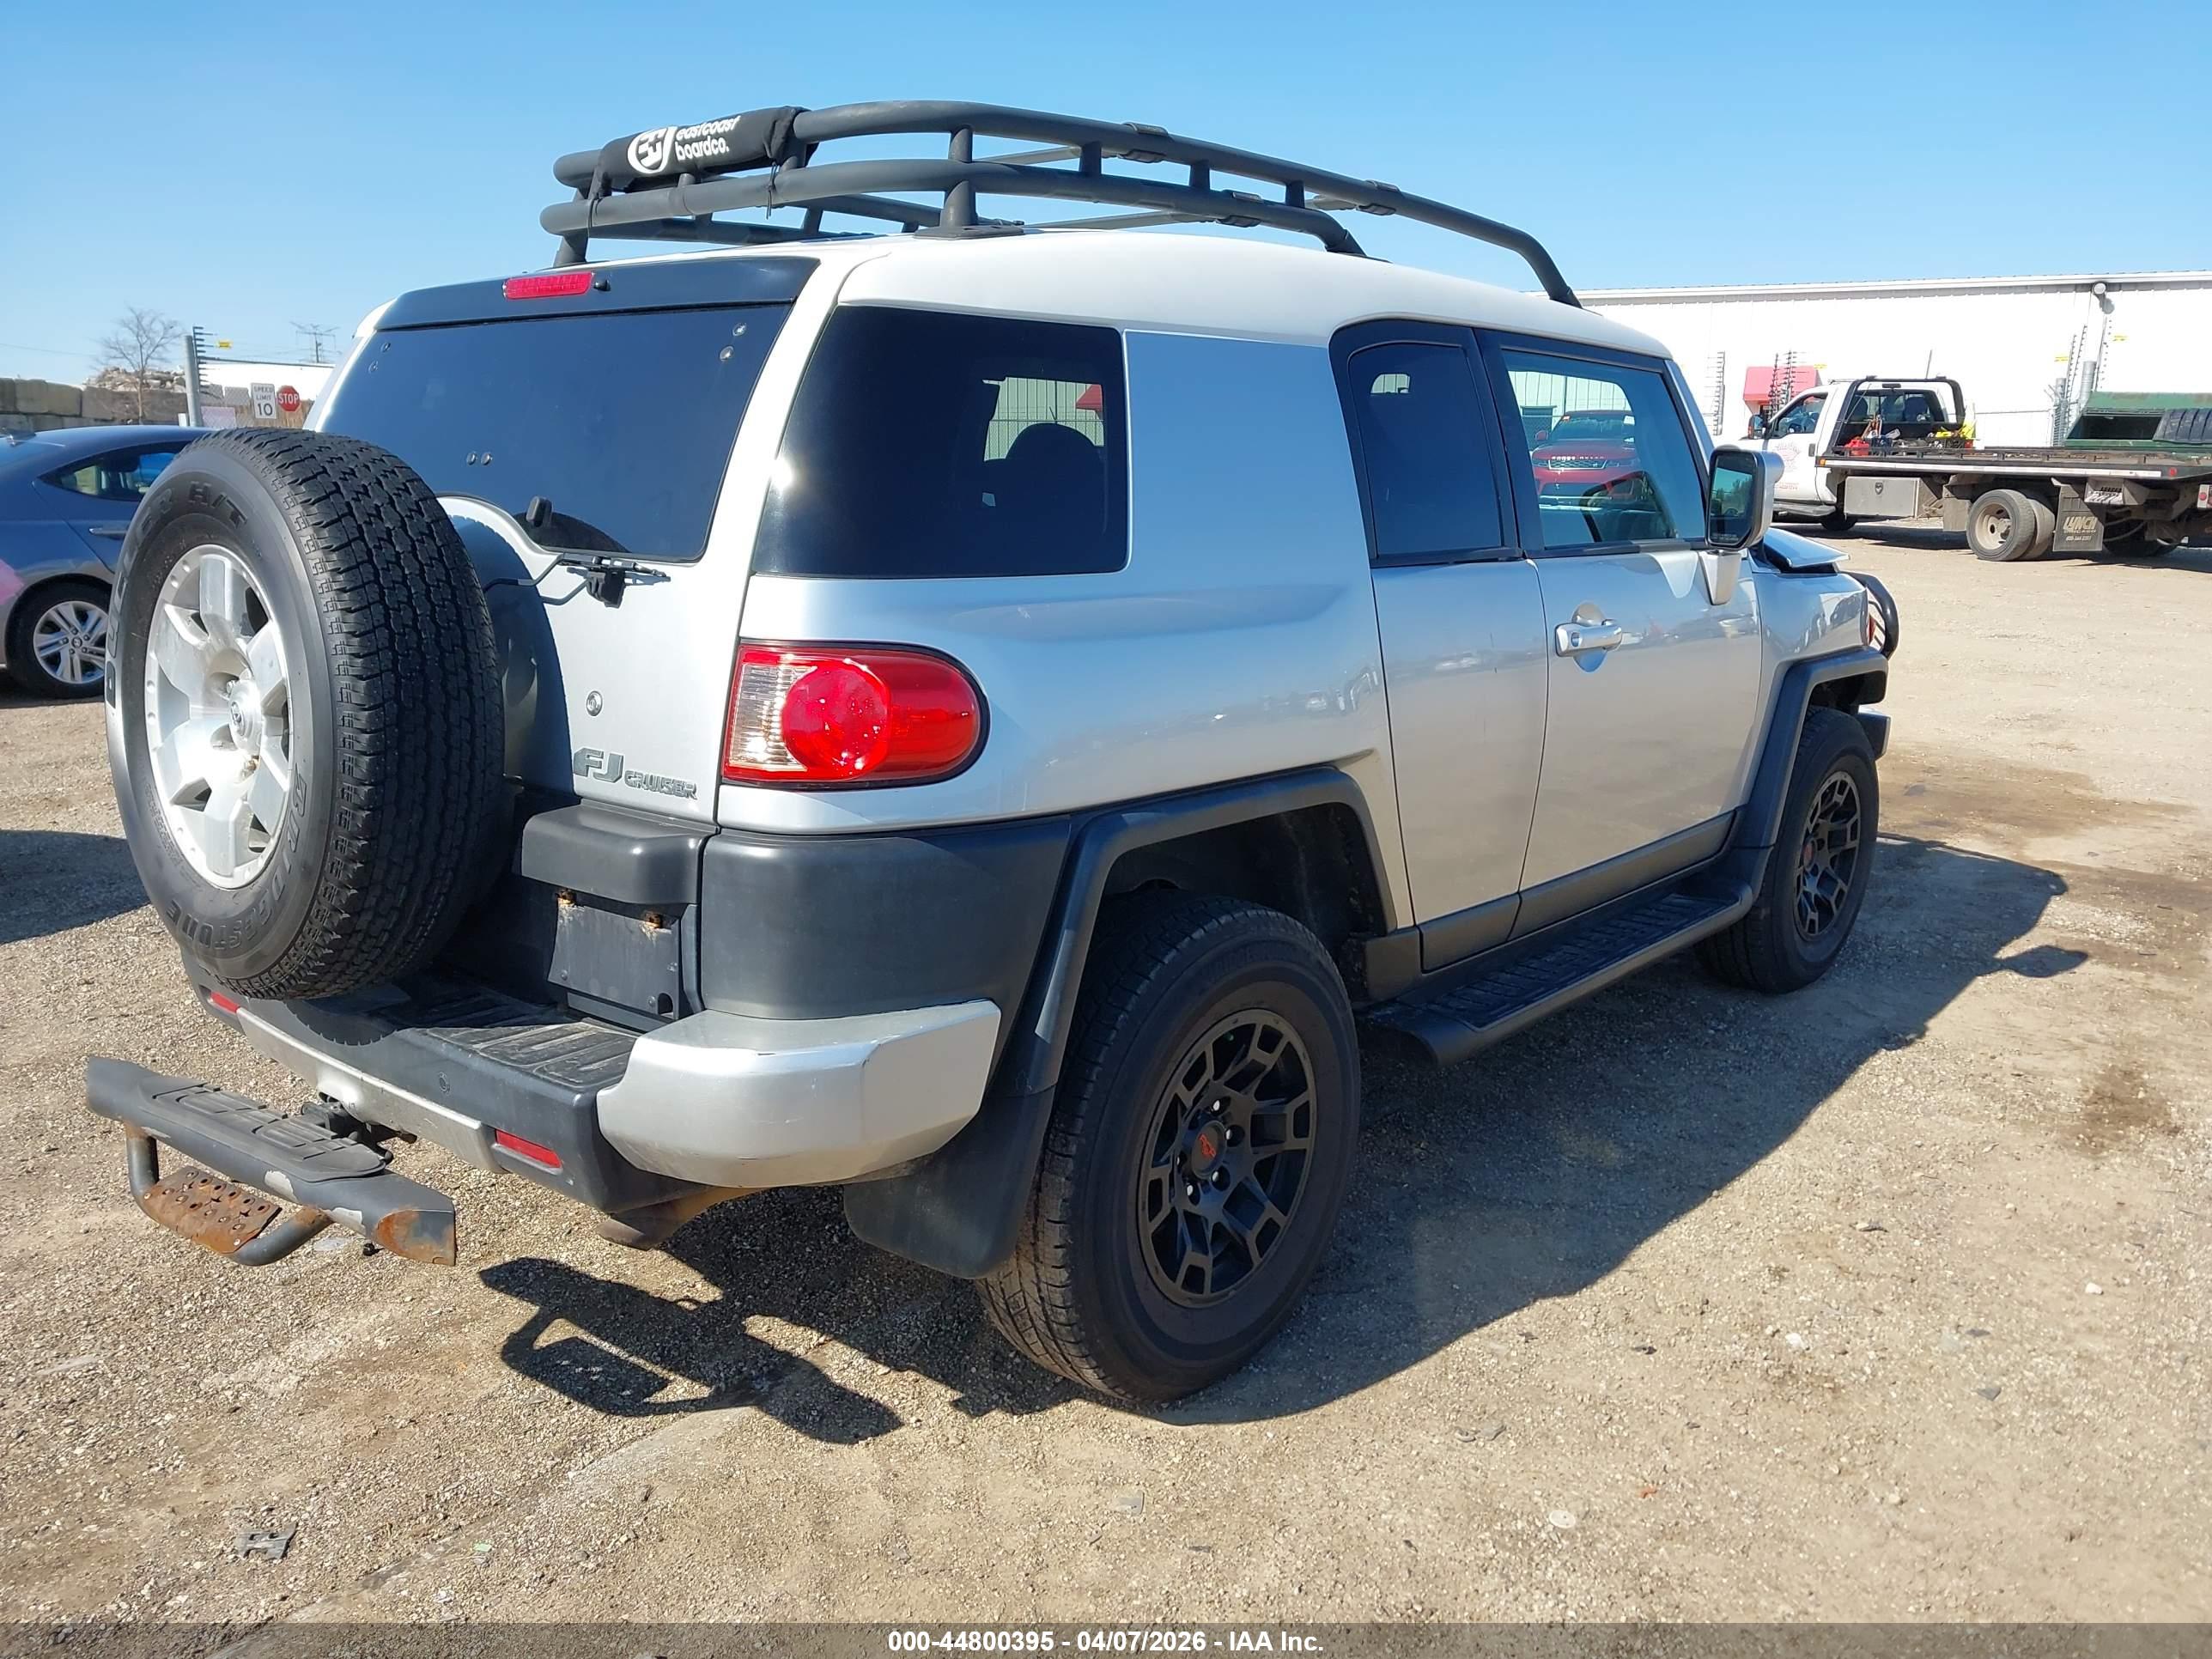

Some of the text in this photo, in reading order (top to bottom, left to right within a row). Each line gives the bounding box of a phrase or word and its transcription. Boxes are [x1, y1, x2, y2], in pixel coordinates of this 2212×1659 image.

[676, 115, 741, 141] eastcoast
[675, 135, 730, 161] boardco.
[258, 403, 273, 416] 10
[278, 392, 300, 405] STOP
[574, 747, 698, 800] FJ CRUISER
